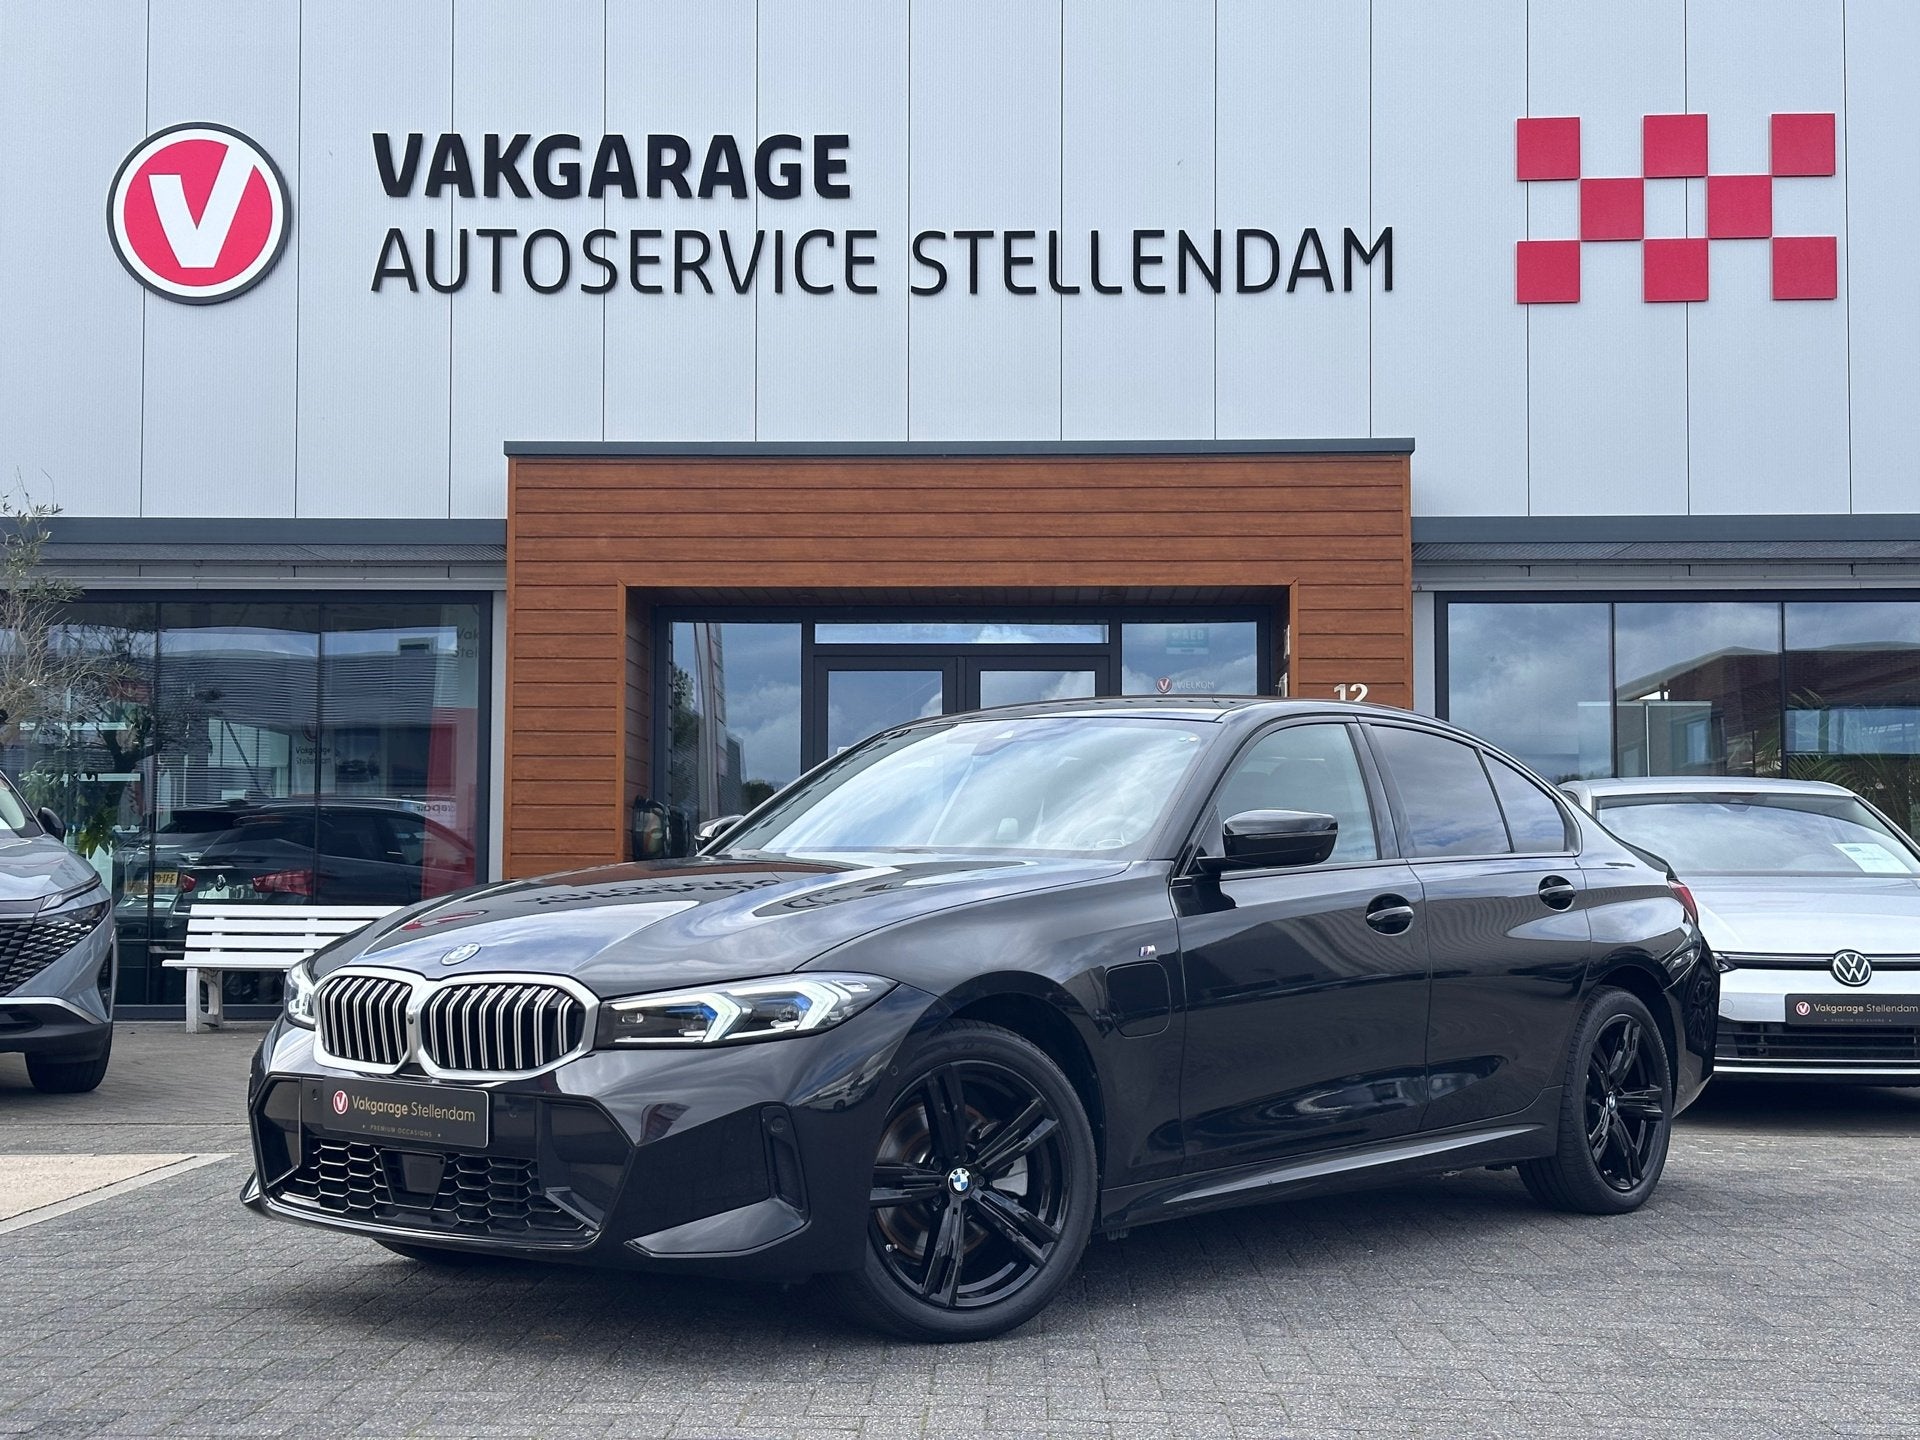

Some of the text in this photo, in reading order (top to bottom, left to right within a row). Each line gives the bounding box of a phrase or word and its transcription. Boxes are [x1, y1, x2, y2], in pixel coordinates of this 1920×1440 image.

[373, 134, 850, 199] VAKGARAGE
[372, 227, 1393, 295] AUTOSERVICE STELLENDAM
[1176, 680, 1215, 689] WELKOM
[1333, 683, 1369, 702] 12
[1813, 1003, 1864, 1014] Vakgarage
[1866, 1004, 1919, 1013] Stellendam
[352, 1095, 408, 1117] Vakgarage
[411, 1101, 476, 1122] Stellendam
[370, 1124, 432, 1137] PREMIUM OCCASIONS
